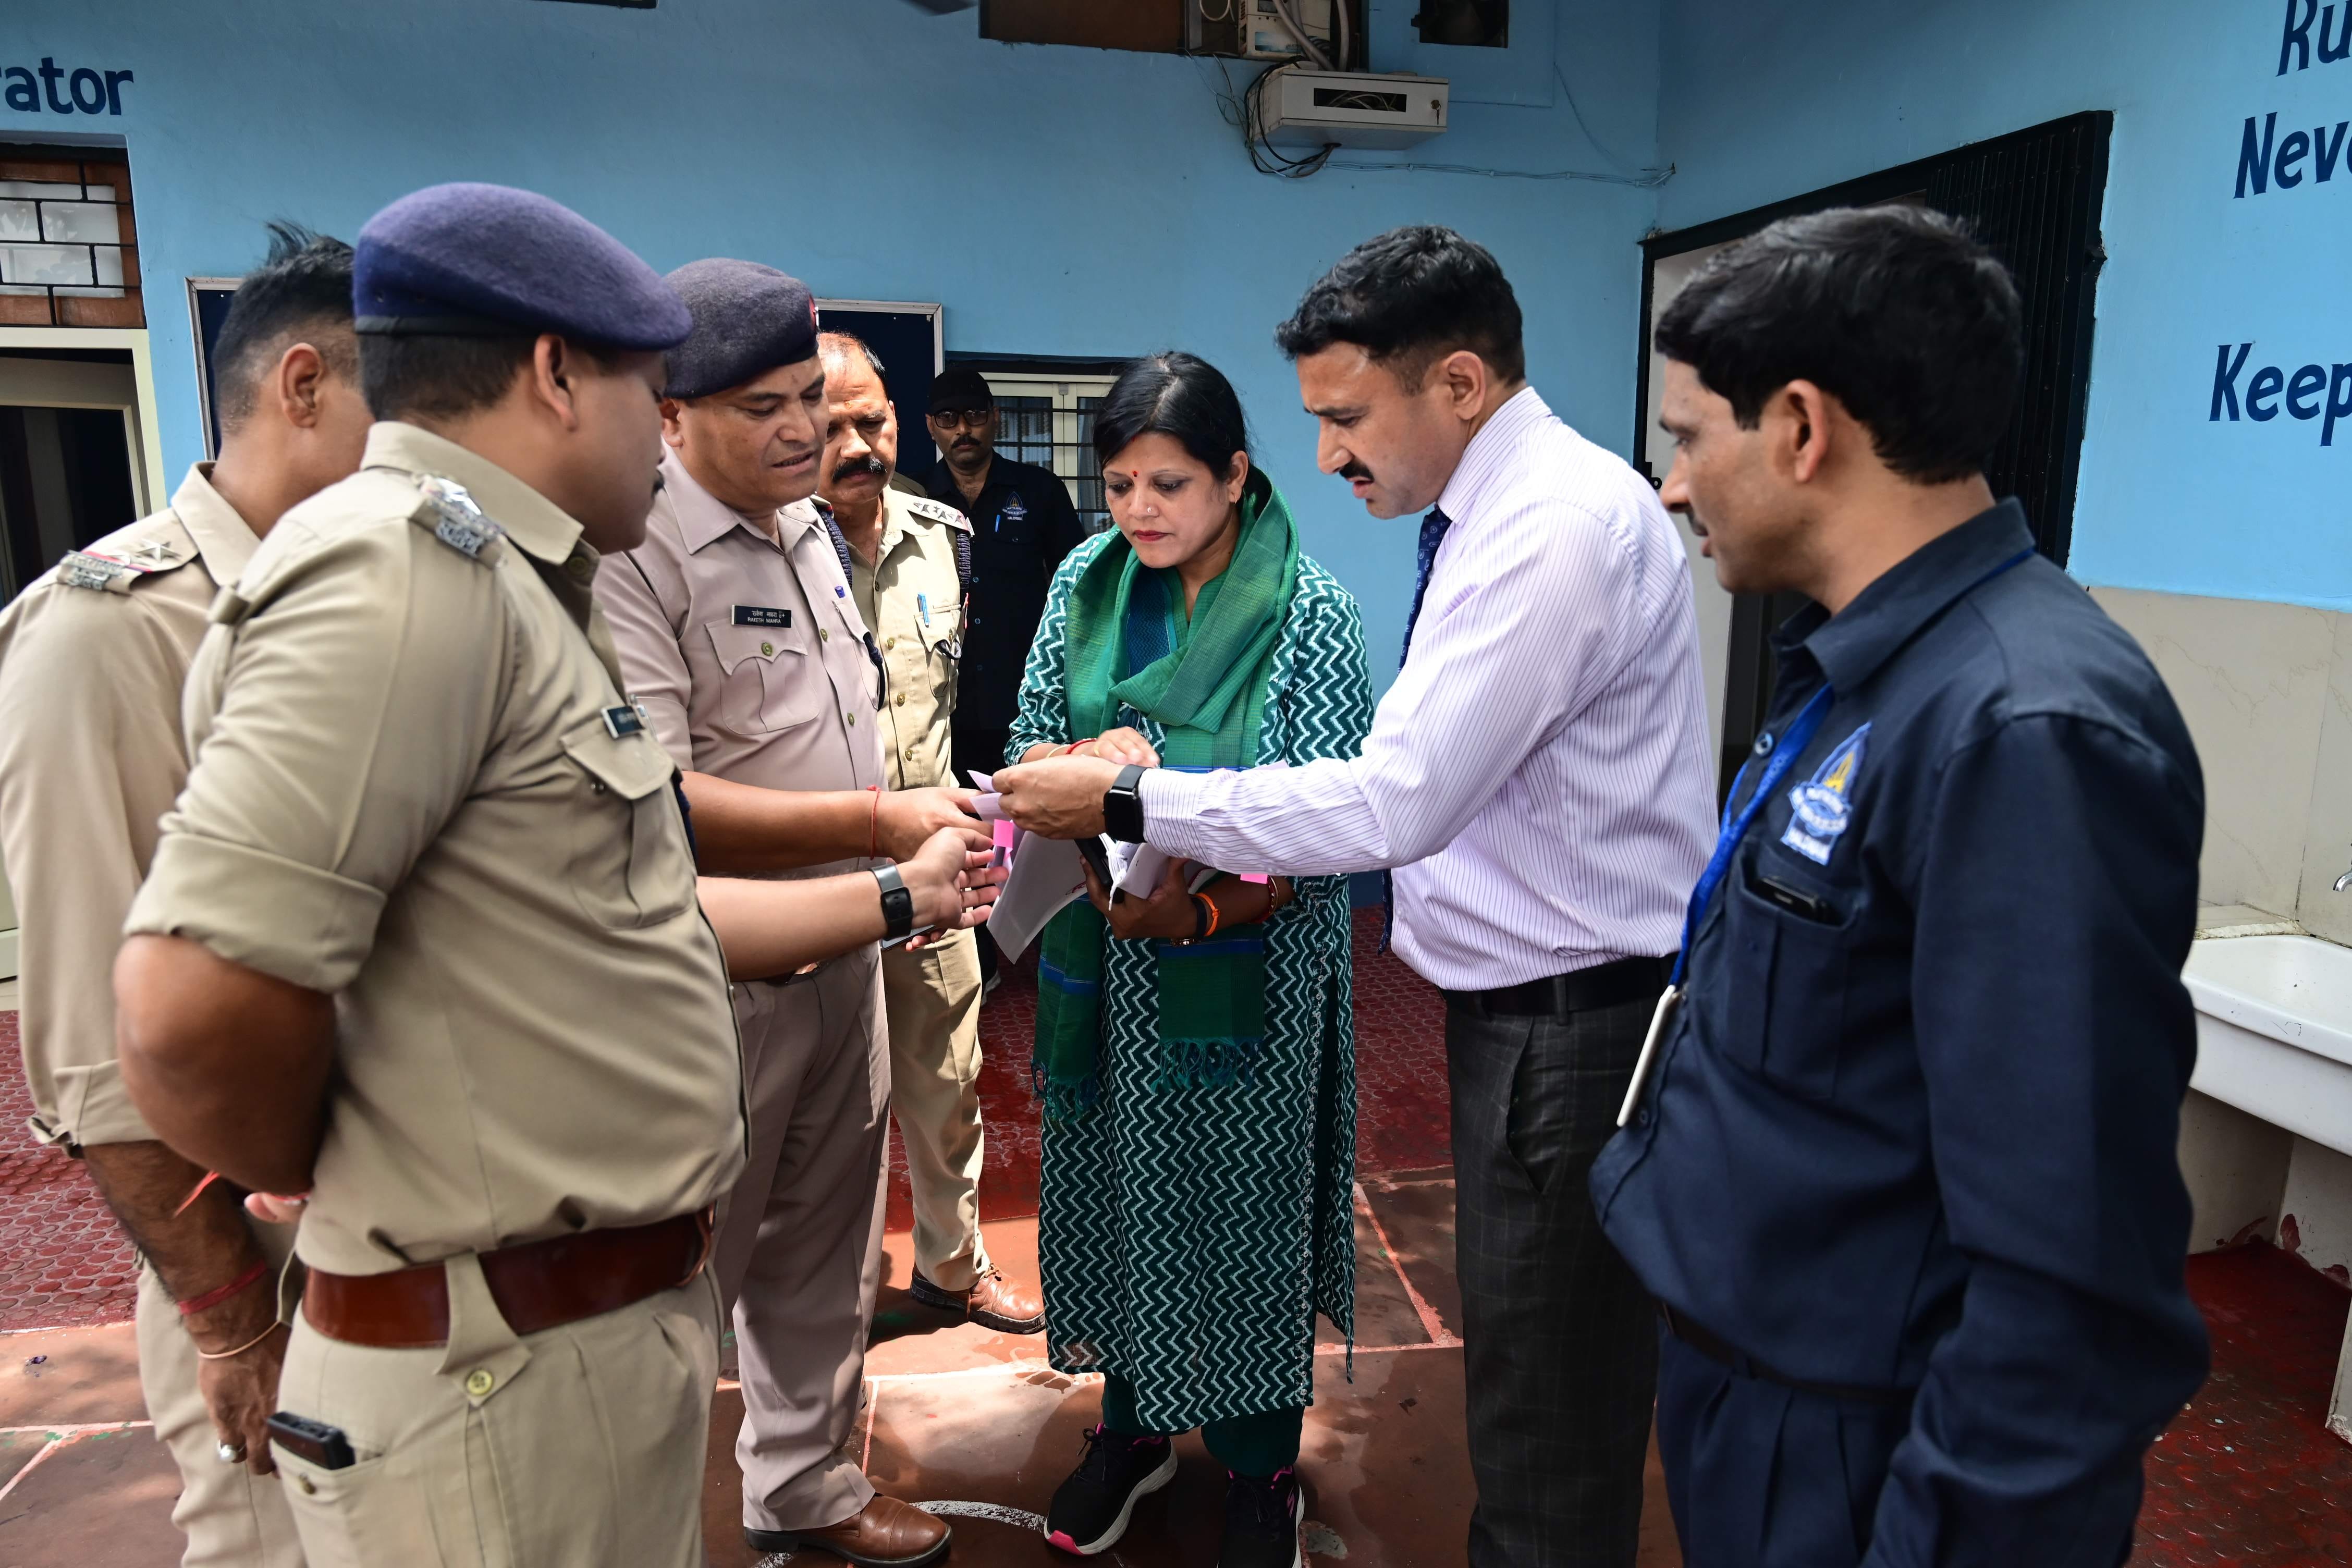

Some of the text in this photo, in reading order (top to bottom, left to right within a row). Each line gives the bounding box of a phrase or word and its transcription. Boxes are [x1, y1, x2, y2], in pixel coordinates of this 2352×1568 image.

[0, 56, 134, 116] ator
[2233, 112, 2352, 200] Nev
[2209, 343, 2352, 446] Keep
